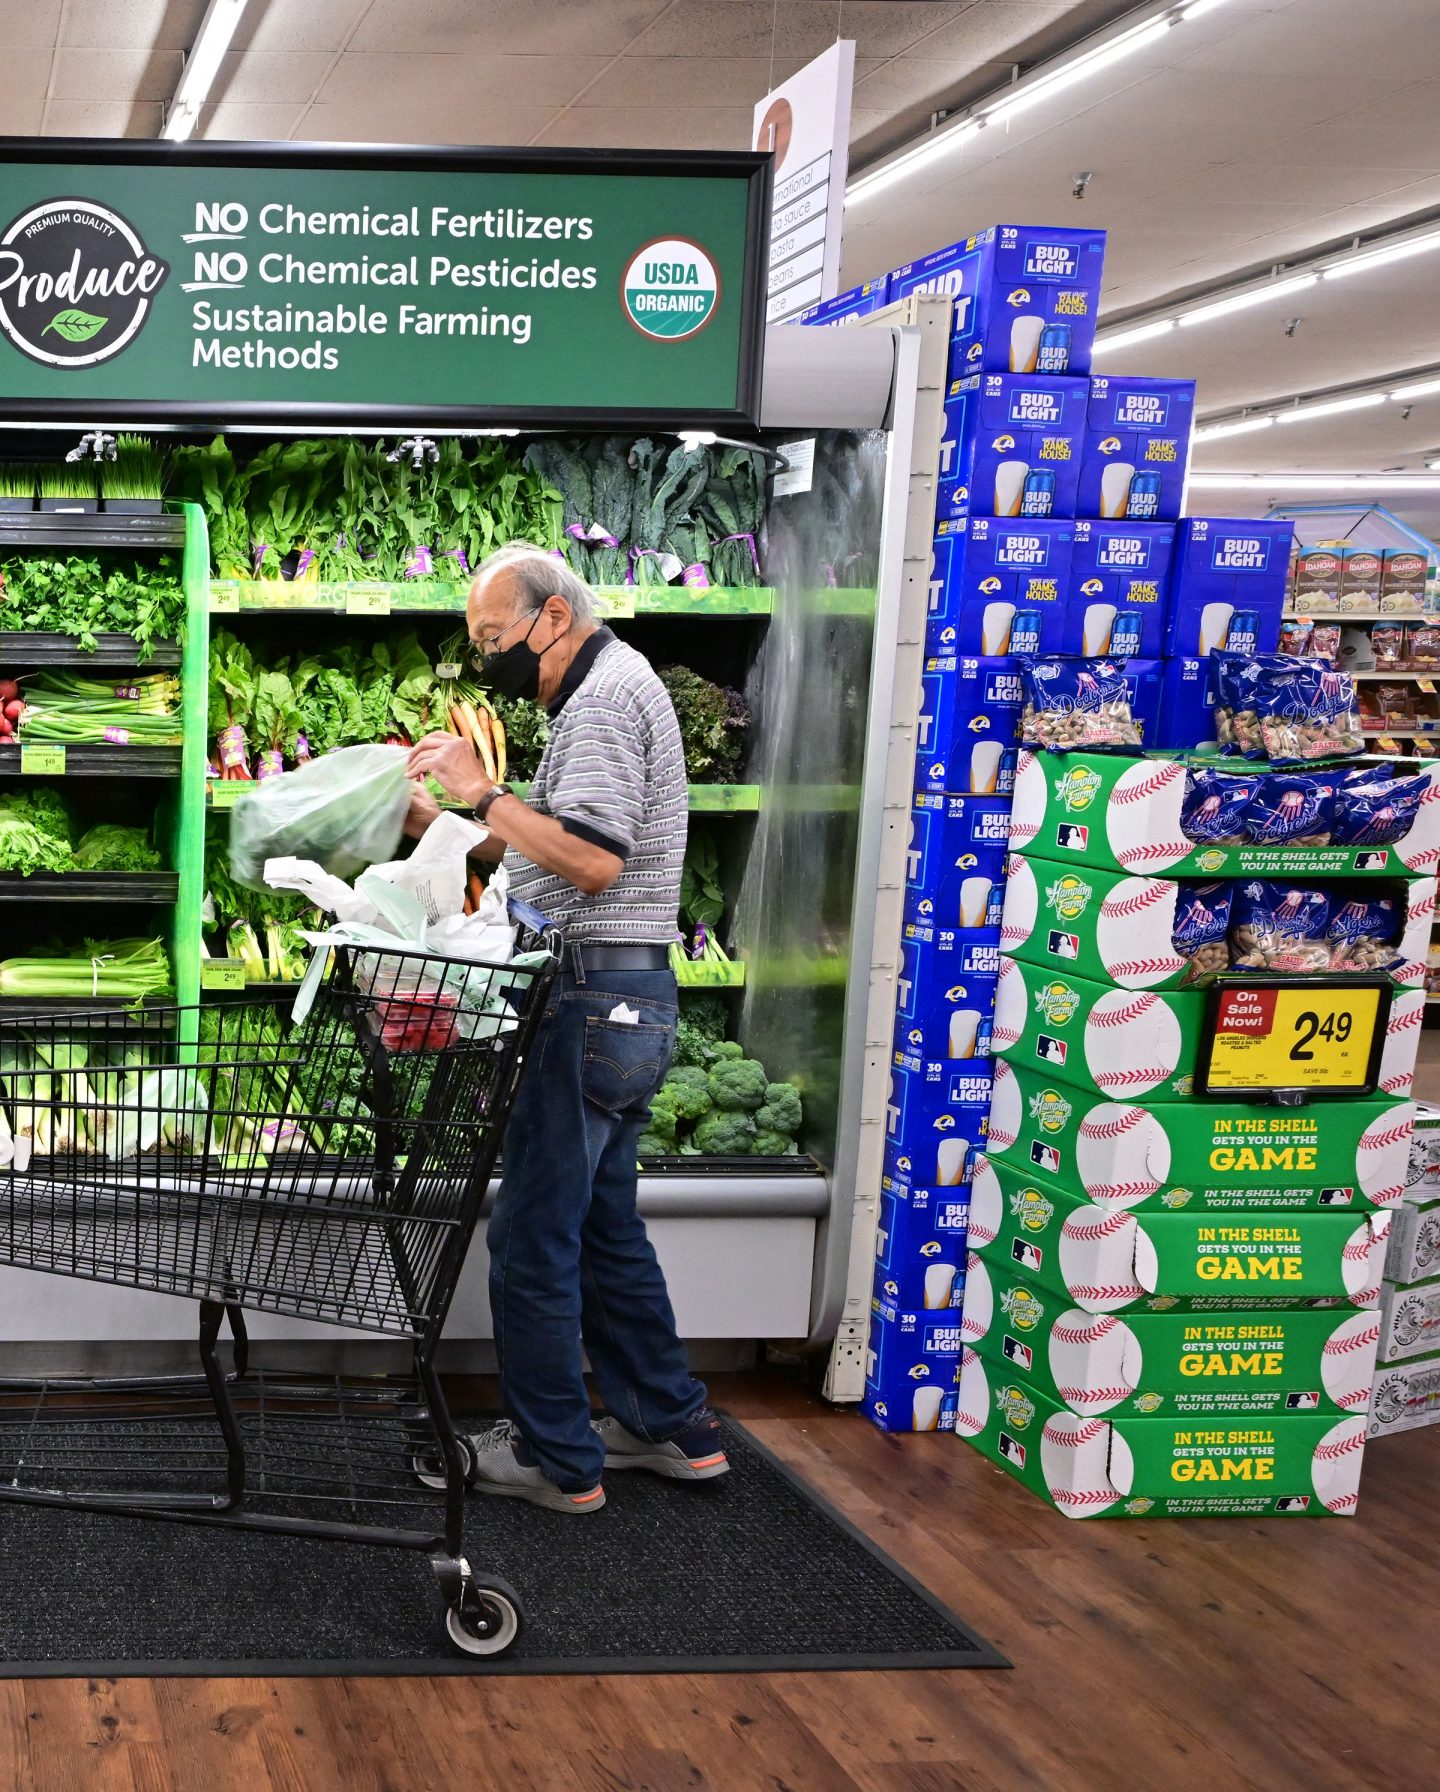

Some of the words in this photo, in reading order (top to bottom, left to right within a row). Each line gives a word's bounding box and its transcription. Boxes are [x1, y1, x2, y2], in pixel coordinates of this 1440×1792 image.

[25, 213, 70, 238] PREMIUM
[73, 213, 116, 237] QUALITY
[196, 202, 248, 232] NO
[259, 203, 419, 236] Chemical
[431, 207, 593, 240] Fertilizers
[1002, 229, 1018, 238] 30
[1035, 246, 1069, 260] BUD
[194, 252, 248, 282] NO
[258, 253, 419, 286] Chemical
[430, 256, 597, 289] Pesticides
[1027, 259, 1075, 274] LIGHT
[644, 262, 698, 285] USDA
[635, 293, 705, 314] ORGANIC
[1059, 296, 1085, 306] RAMS
[1054, 305, 1088, 315] HOUSE!
[192, 301, 388, 334] Sustainable
[398, 304, 532, 344] Farming
[192, 338, 339, 370] Methods
[1042, 348, 1067, 358] BUD
[1036, 358, 1068, 370] LIGHT
[987, 377, 1002, 386] 30
[1093, 379, 1108, 388] 30
[1020, 393, 1054, 406] BUD
[1126, 396, 1159, 410] BUD
[1012, 406, 1059, 421] LIGHT
[1118, 409, 1164, 424] LIGHT
[1044, 442, 1070, 451] RAMS
[1149, 442, 1174, 452] RAMS
[1039, 450, 1071, 460] HOUSE!
[1144, 451, 1176, 462] HOUSE!
[973, 520, 988, 530] 30
[1076, 522, 1091, 532] 30
[1193, 521, 1209, 531] 30
[1006, 536, 1040, 550] BUD
[1108, 538, 1142, 552] BUD
[1224, 538, 1260, 553] BUD
[998, 549, 1045, 564] LIGHT
[1100, 551, 1148, 566] LIGHT
[1215, 552, 1266, 568] LIGHT
[1304, 562, 1336, 571] IDAHOAN
[1349, 562, 1378, 571] IDAHOAN
[1391, 562, 1422, 572] IDAHOAN
[1030, 582, 1056, 592] RAMS
[1130, 584, 1156, 594] RAMS
[1026, 590, 1057, 601] HOUSE!
[1126, 592, 1158, 603] HOUSE!
[963, 660, 978, 669] 30
[1054, 770, 1102, 801] Hampton
[949, 799, 964, 808] 30
[1066, 787, 1098, 812] Farms
[974, 826, 1009, 838] LIGH
[1239, 852, 1253, 861] IN
[1256, 852, 1280, 861] THE
[1280, 852, 1318, 861] SHELL
[1320, 852, 1350, 861] GETS
[1242, 862, 1266, 871] YOU
[1266, 862, 1282, 871] IN
[1283, 862, 1307, 871] THE
[1308, 862, 1343, 871] GAME
[940, 932, 954, 940] 30
[964, 959, 998, 972] LIGH
[1236, 992, 1258, 1002] On
[1227, 1004, 1262, 1014] Sale
[1223, 1016, 1262, 1027] Now!
[1290, 1011, 1352, 1060] 249
[927, 1064, 942, 1072] 30
[960, 1078, 990, 1090] BUD
[1029, 1092, 1072, 1117] Hampton
[1039, 1110, 1068, 1133] Farms
[1214, 1120, 1233, 1133] IN
[1235, 1119, 1267, 1132] THE
[1269, 1119, 1318, 1132] SHELL
[1212, 1135, 1244, 1145] GETS
[1247, 1135, 1272, 1145] YOU
[1275, 1135, 1289, 1145] IN
[1291, 1135, 1318, 1145] THE
[1411, 1137, 1428, 1152] LAW
[1209, 1147, 1318, 1171] GAME
[914, 1191, 928, 1199] 30
[1393, 1300, 1409, 1330] WHITE
[1408, 1295, 1426, 1308] CLAW
[902, 1315, 916, 1323] 30
[926, 1340, 960, 1351] LIGH
[1374, 1380, 1390, 1408] WHITE
[1390, 1374, 1409, 1386] CLAW
[1174, 1432, 1192, 1445] IN
[1195, 1431, 1225, 1445] THE
[1228, 1431, 1275, 1444] SHELL
[1173, 1447, 1204, 1457] GETS
[1207, 1447, 1232, 1456] YOU
[1234, 1446, 1248, 1456] IN
[1250, 1446, 1275, 1455] THE
[1171, 1457, 1275, 1482] GAME
